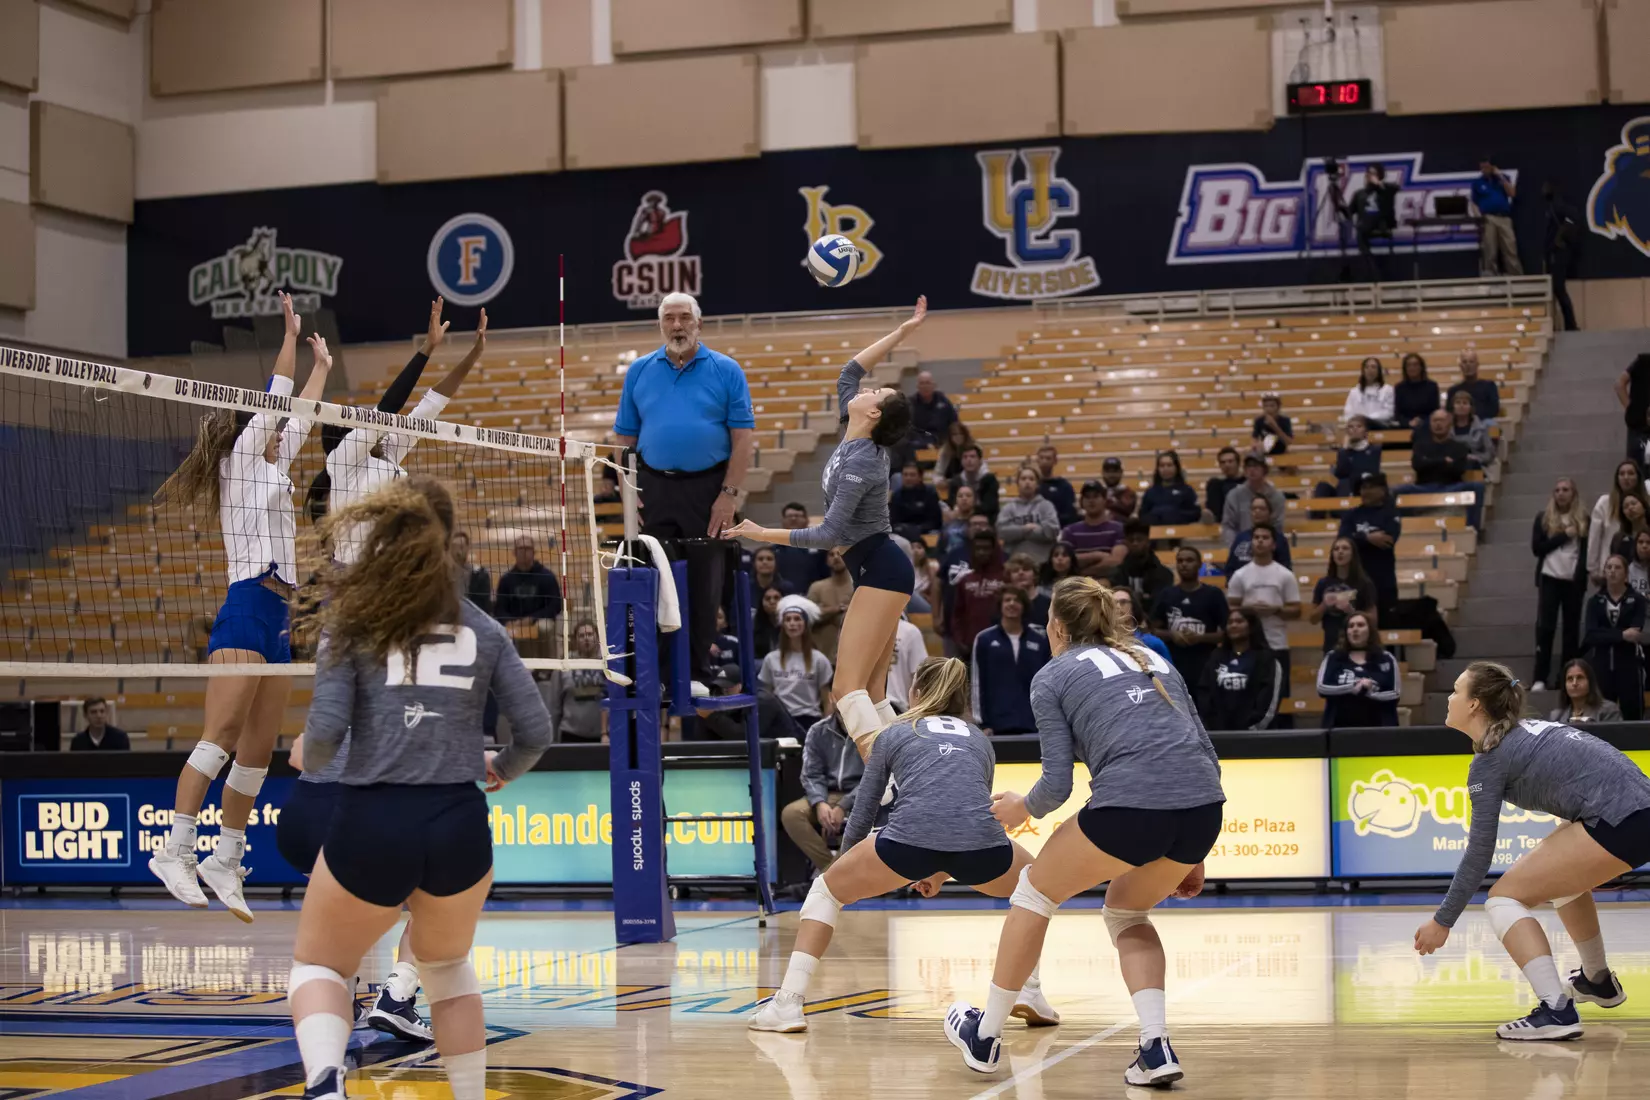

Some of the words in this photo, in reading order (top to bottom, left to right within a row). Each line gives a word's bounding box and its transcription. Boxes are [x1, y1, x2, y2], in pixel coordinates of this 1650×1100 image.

[1314, 83, 1359, 105] 7:10
[977, 148, 1080, 267] UC
[191, 254, 241, 302] CAL
[275, 252, 341, 297] POLY
[457, 236, 487, 286] F
[615, 258, 698, 297] CSUN
[974, 261, 1097, 297] RIVERSIDE
[0, 347, 52, 374] IVERSIDE
[55, 357, 117, 384] VOLLEYBALL
[174, 378, 189, 396] UC
[191, 381, 240, 404] RIVERSIDE
[242, 389, 293, 413] VOLLEYBALL
[340, 404, 353, 420] UC
[355, 408, 394, 428] RIVERSIDE
[396, 413, 438, 435] VOLLEYBALL
[476, 427, 486, 442] UC
[487, 429, 520, 448] RIVERSIDE
[385, 624, 478, 690] 12
[1076, 645, 1171, 680] 10
[924, 715, 971, 737] 8
[38, 801, 110, 831] BUD
[263, 802, 281, 827] fo
[630, 781, 642, 821] sports
[1253, 817, 1296, 833] Plaza
[1517, 834, 1546, 849] Ter
[25, 830, 124, 860] LIGHT
[1211, 843, 1299, 857] 51-300-2029
